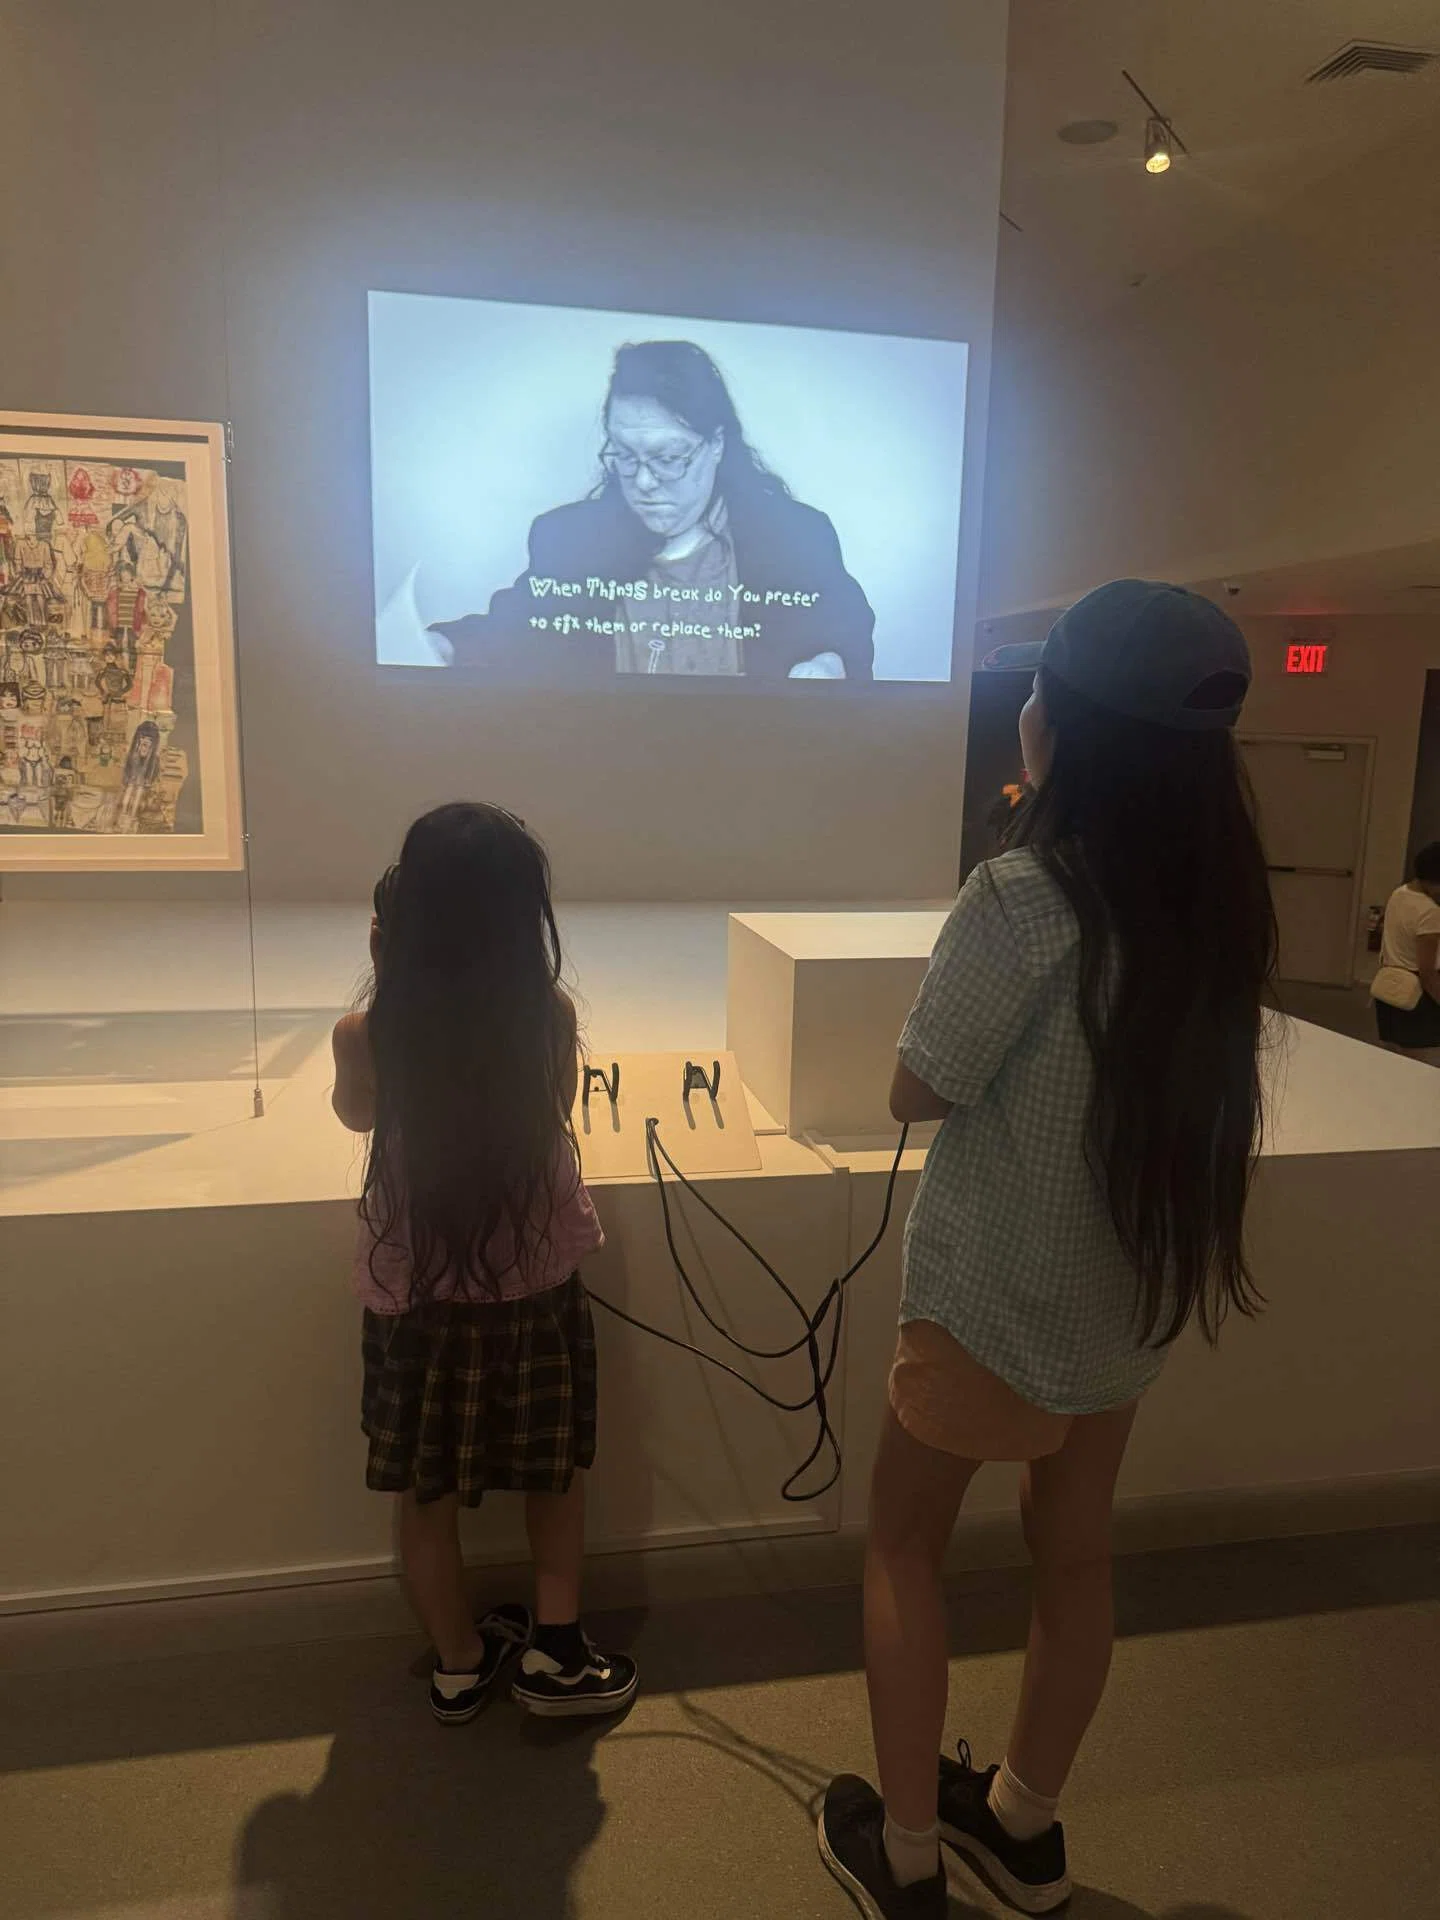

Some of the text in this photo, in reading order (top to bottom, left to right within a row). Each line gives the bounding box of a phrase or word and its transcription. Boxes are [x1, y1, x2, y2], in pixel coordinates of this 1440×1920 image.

[529, 576, 582, 597] When
[653, 584, 699, 602] break
[704, 588, 722, 602] do
[728, 584, 761, 602] You
[765, 590, 820, 606] prefer
[529, 613, 761, 639] to fix them or replace them?
[1286, 645, 1328, 673] EXIT
